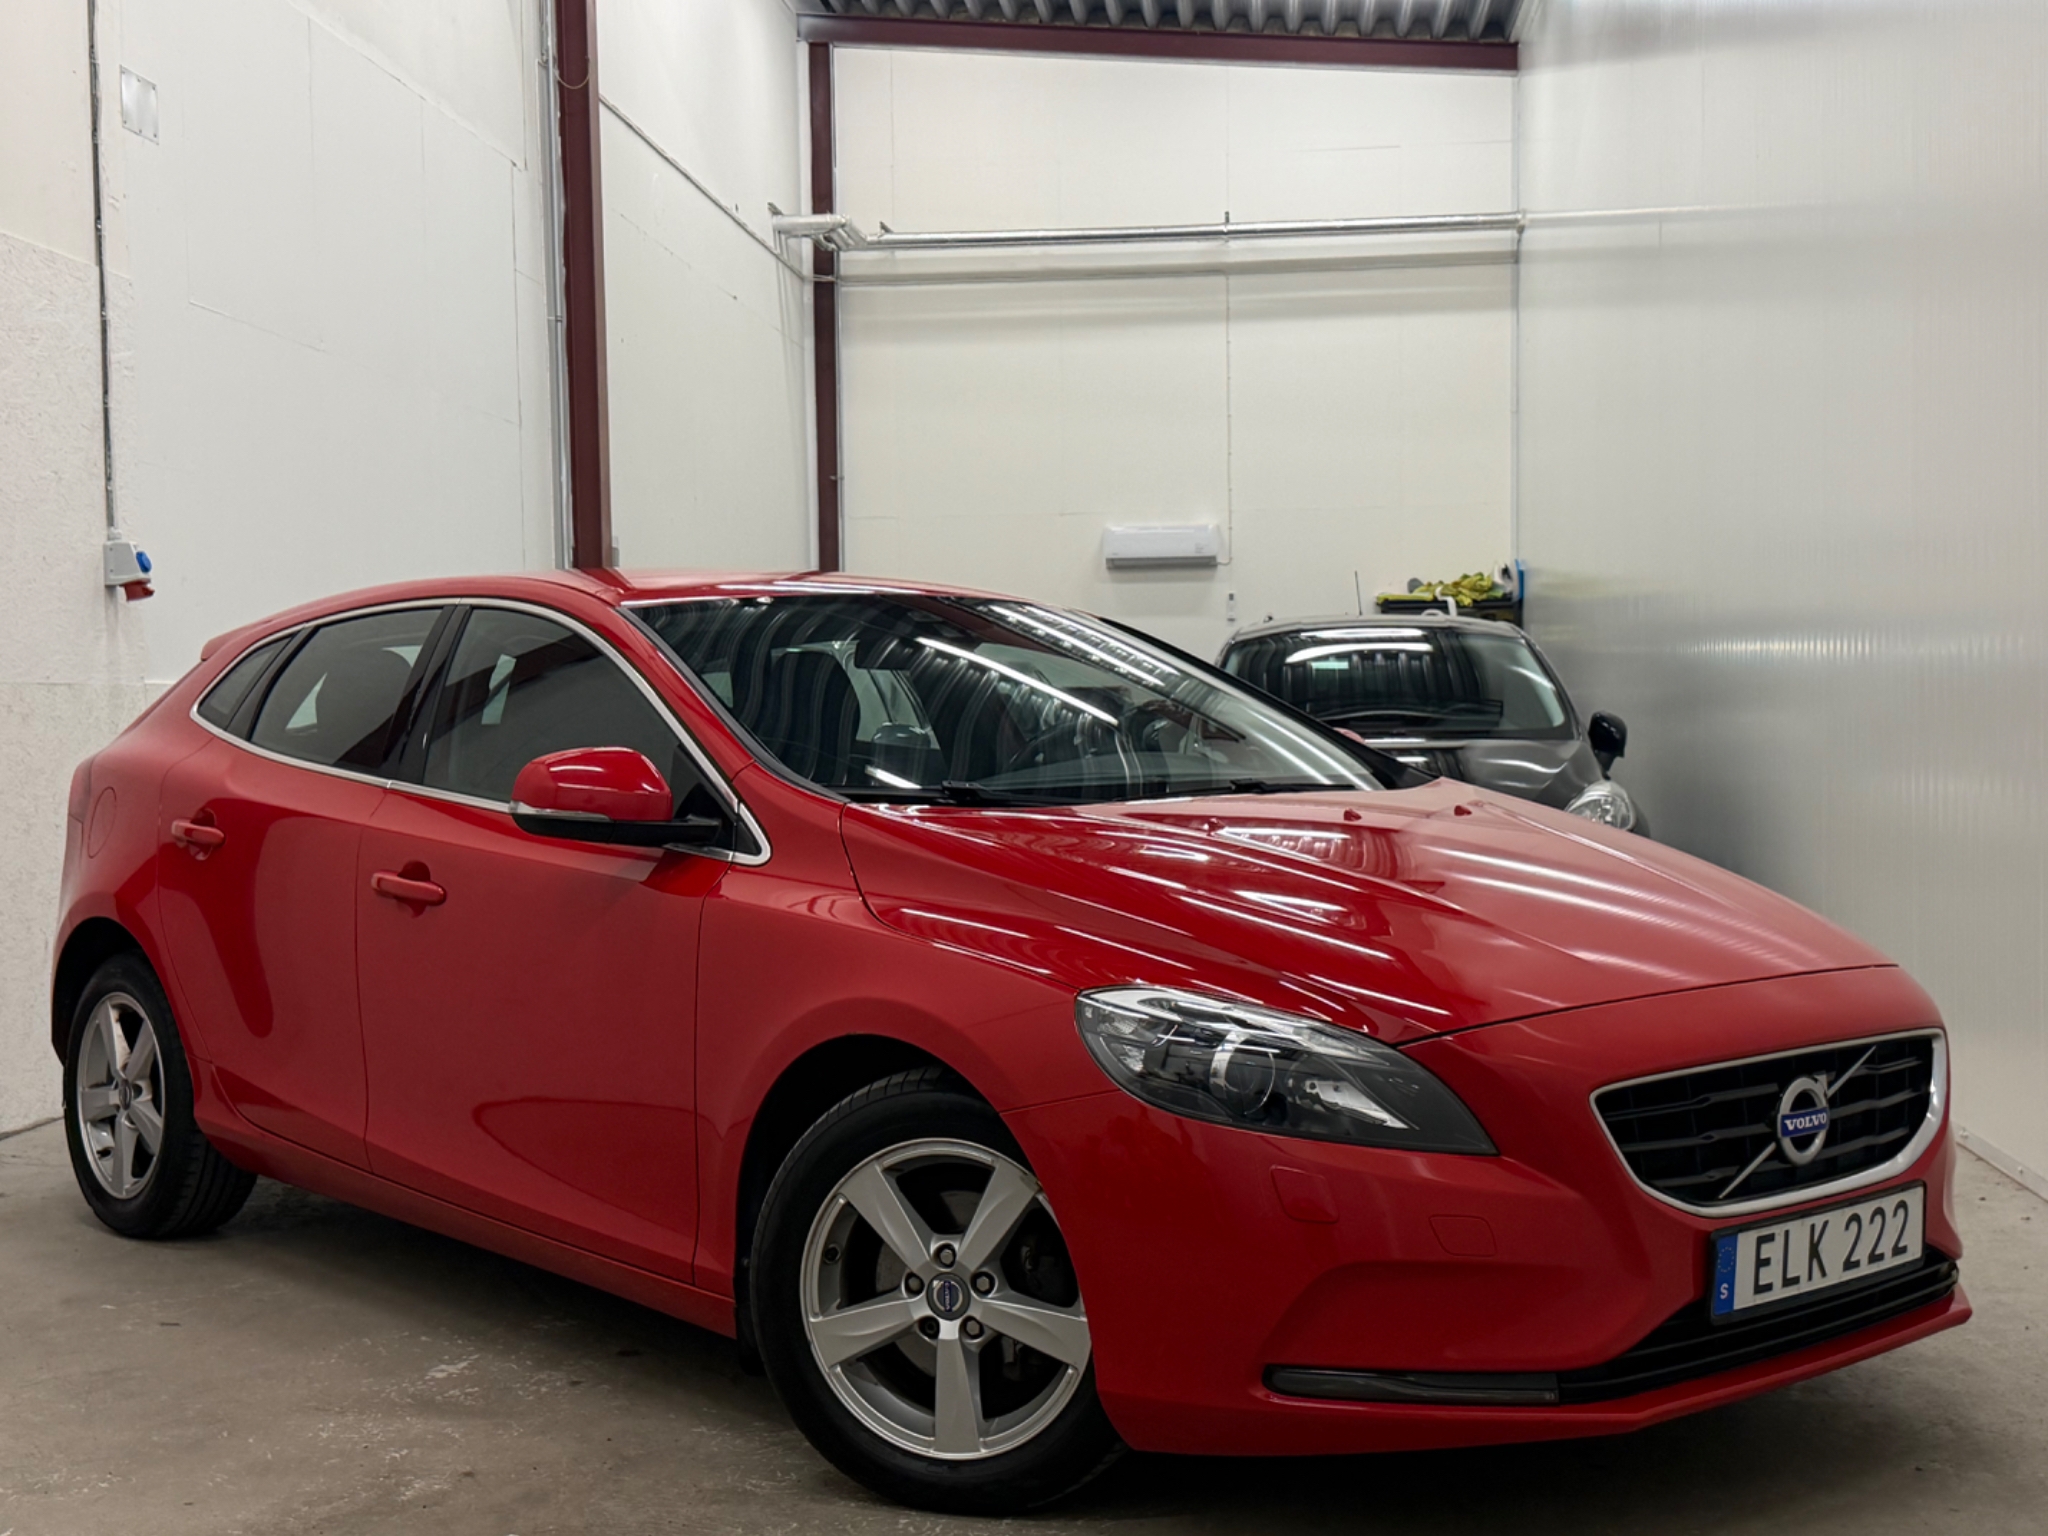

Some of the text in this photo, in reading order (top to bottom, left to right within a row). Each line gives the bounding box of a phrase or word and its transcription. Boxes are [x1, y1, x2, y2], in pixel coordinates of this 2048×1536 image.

[1784, 1112, 1827, 1131] VOLVO
[1753, 1199, 1909, 1295] ELK 222
[1720, 1283, 1729, 1300] S
